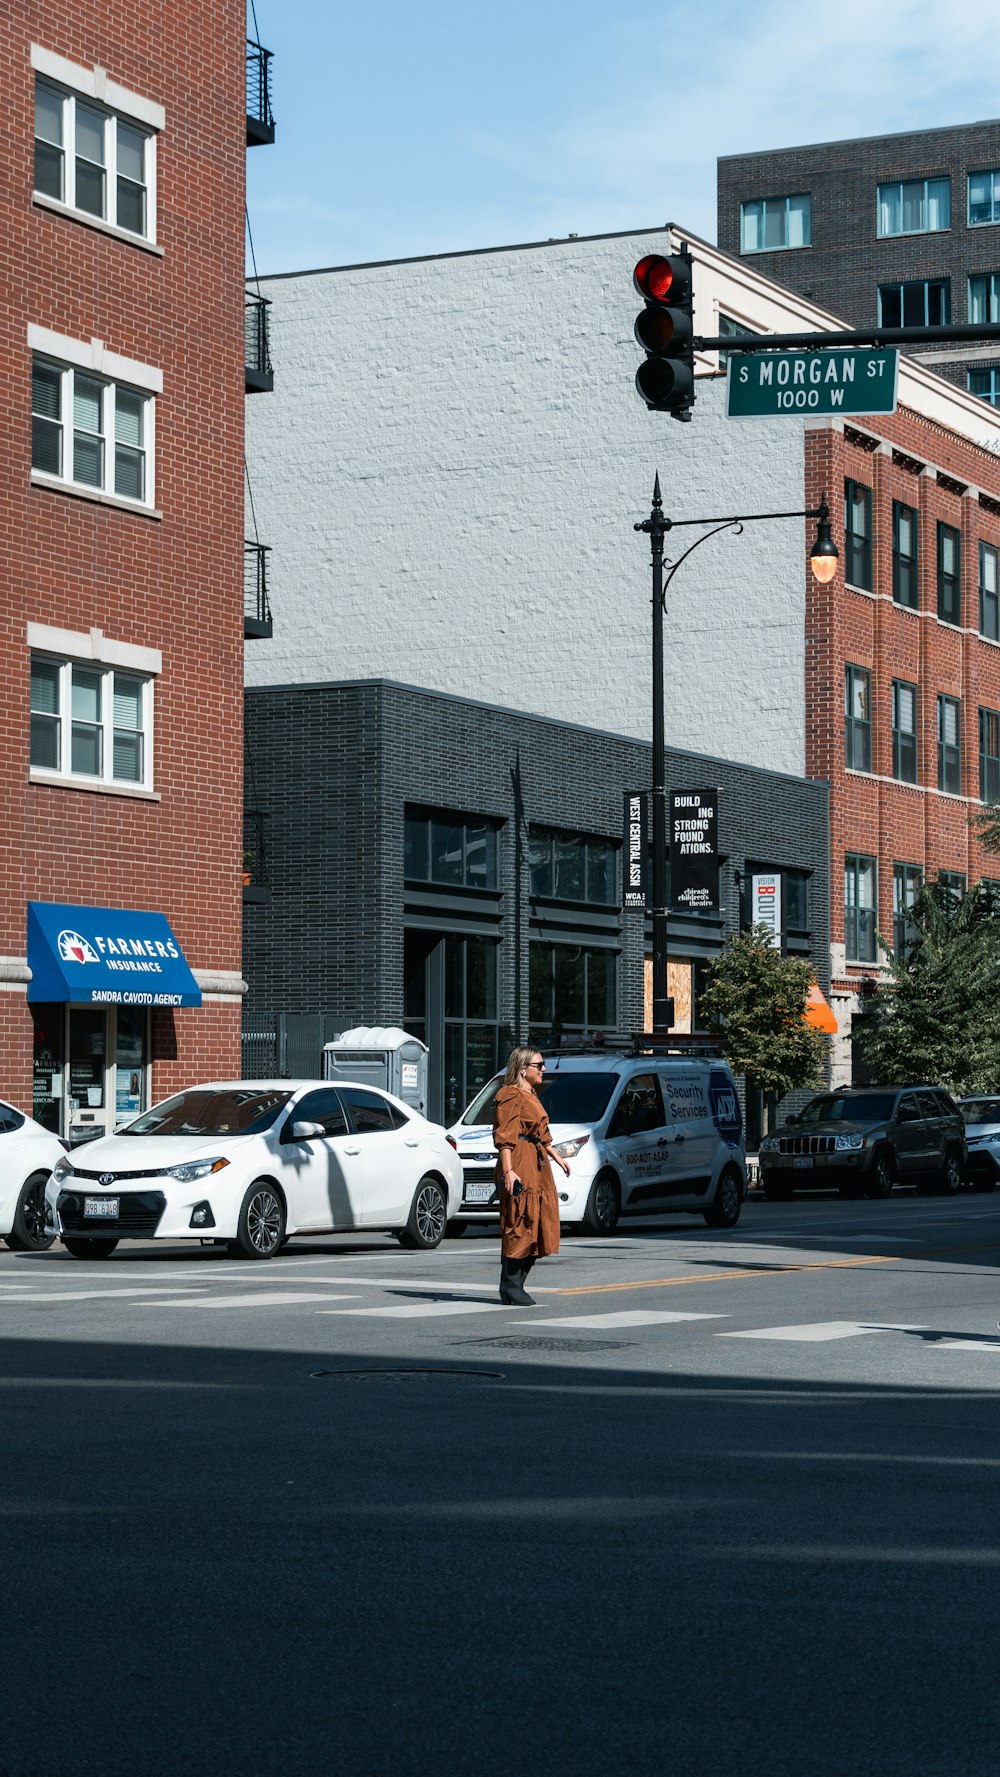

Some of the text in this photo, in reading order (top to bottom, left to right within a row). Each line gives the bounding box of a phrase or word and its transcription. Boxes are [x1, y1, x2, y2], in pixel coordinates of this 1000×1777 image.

[739, 357, 886, 386] S MORGAN ST
[777, 389, 844, 409] 1000 W
[674, 796, 701, 807] BUILD
[629, 796, 641, 822] WEST
[698, 807, 714, 818] ING
[674, 819, 709, 831] STRONG
[629, 823, 641, 862] CENTRAL
[674, 831, 704, 843] FOUND
[680, 843, 714, 855] ATIONS.
[629, 863, 641, 887] ASSN
[757, 877, 775, 885] VISION
[106, 960, 162, 973] INSURANCE
[92, 990, 182, 1005] SANDRA CAVOTO AGENCY
[666, 1084, 704, 1102] Security
[670, 1103, 708, 1118] Services
[626, 1151, 669, 1165] 800-ADT-ASAP
